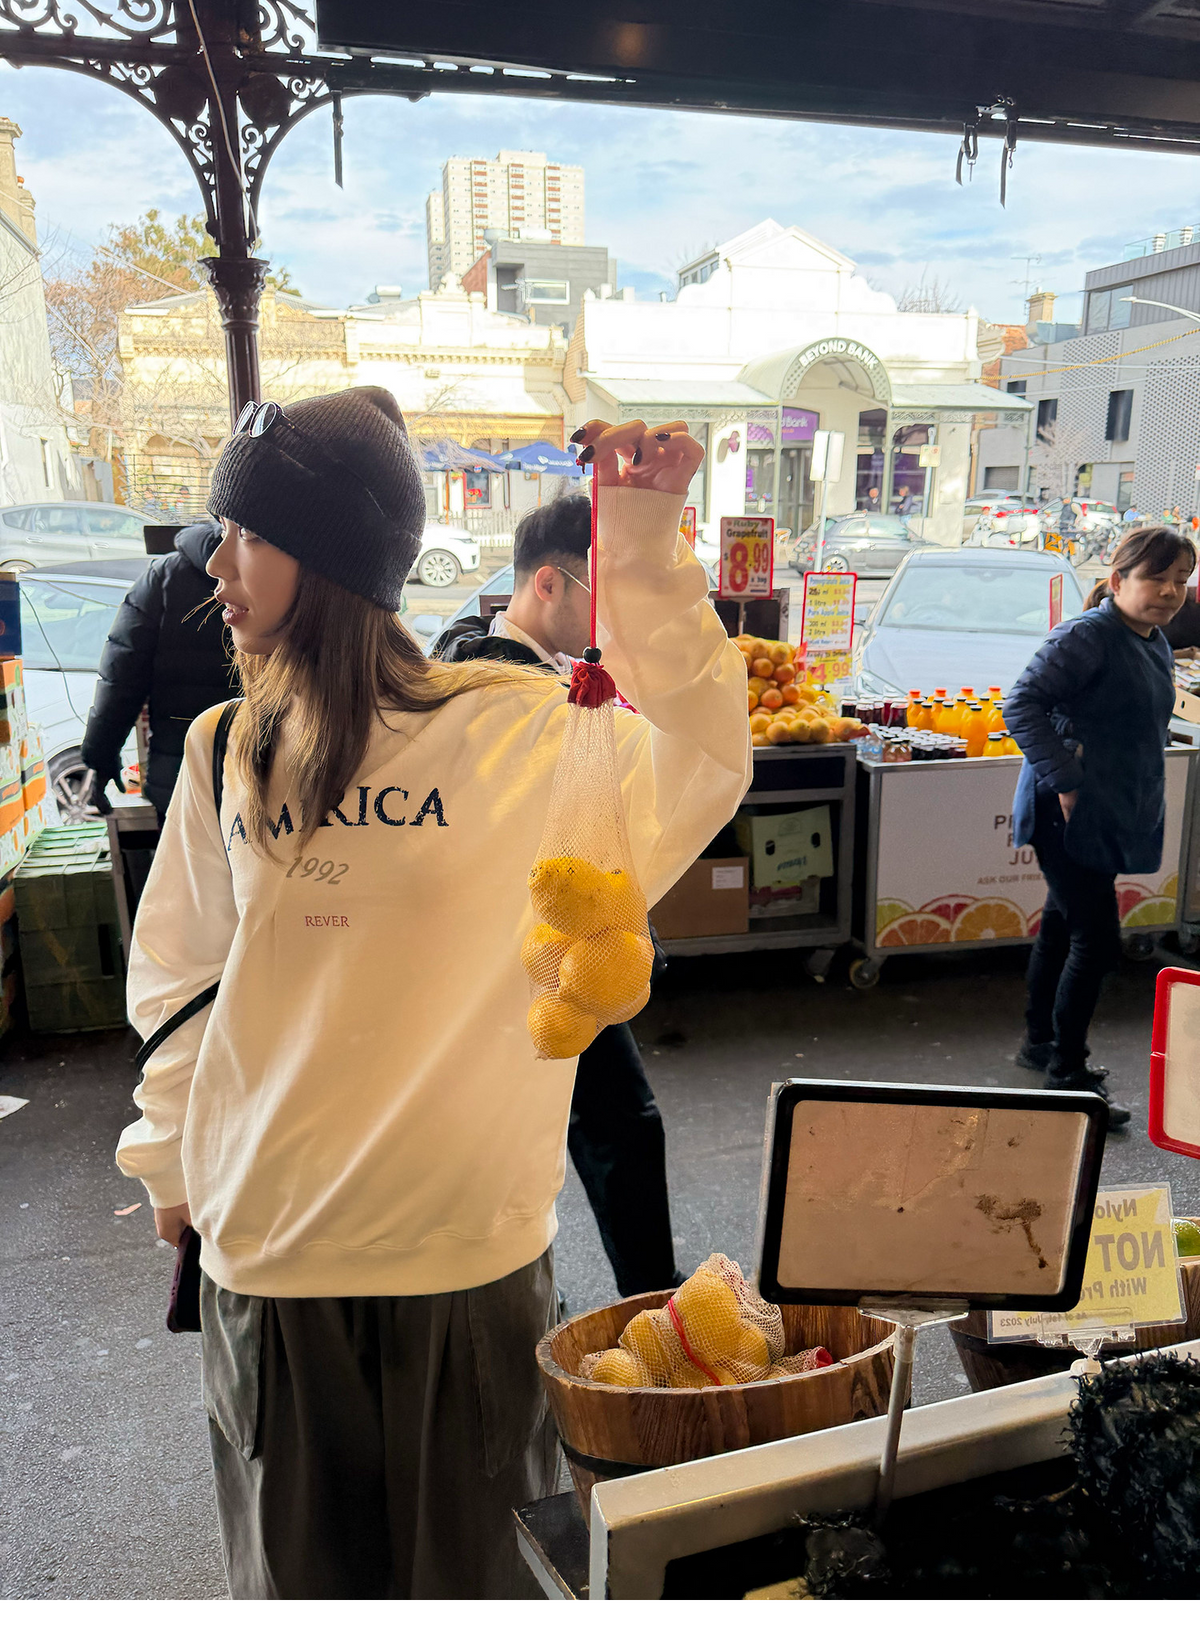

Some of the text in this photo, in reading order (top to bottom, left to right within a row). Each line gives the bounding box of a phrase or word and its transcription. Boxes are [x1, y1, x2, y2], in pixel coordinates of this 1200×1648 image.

[798, 340, 879, 370] BEYOND BANK
[733, 519, 760, 530] Ruby
[726, 528, 768, 539] Grapefruit
[227, 786, 449, 851] AMRICA
[1008, 850, 1034, 866] JU
[285, 856, 349, 885] 1992
[977, 872, 1043, 885] ASK OUR FRIE
[305, 915, 350, 927] REVER
